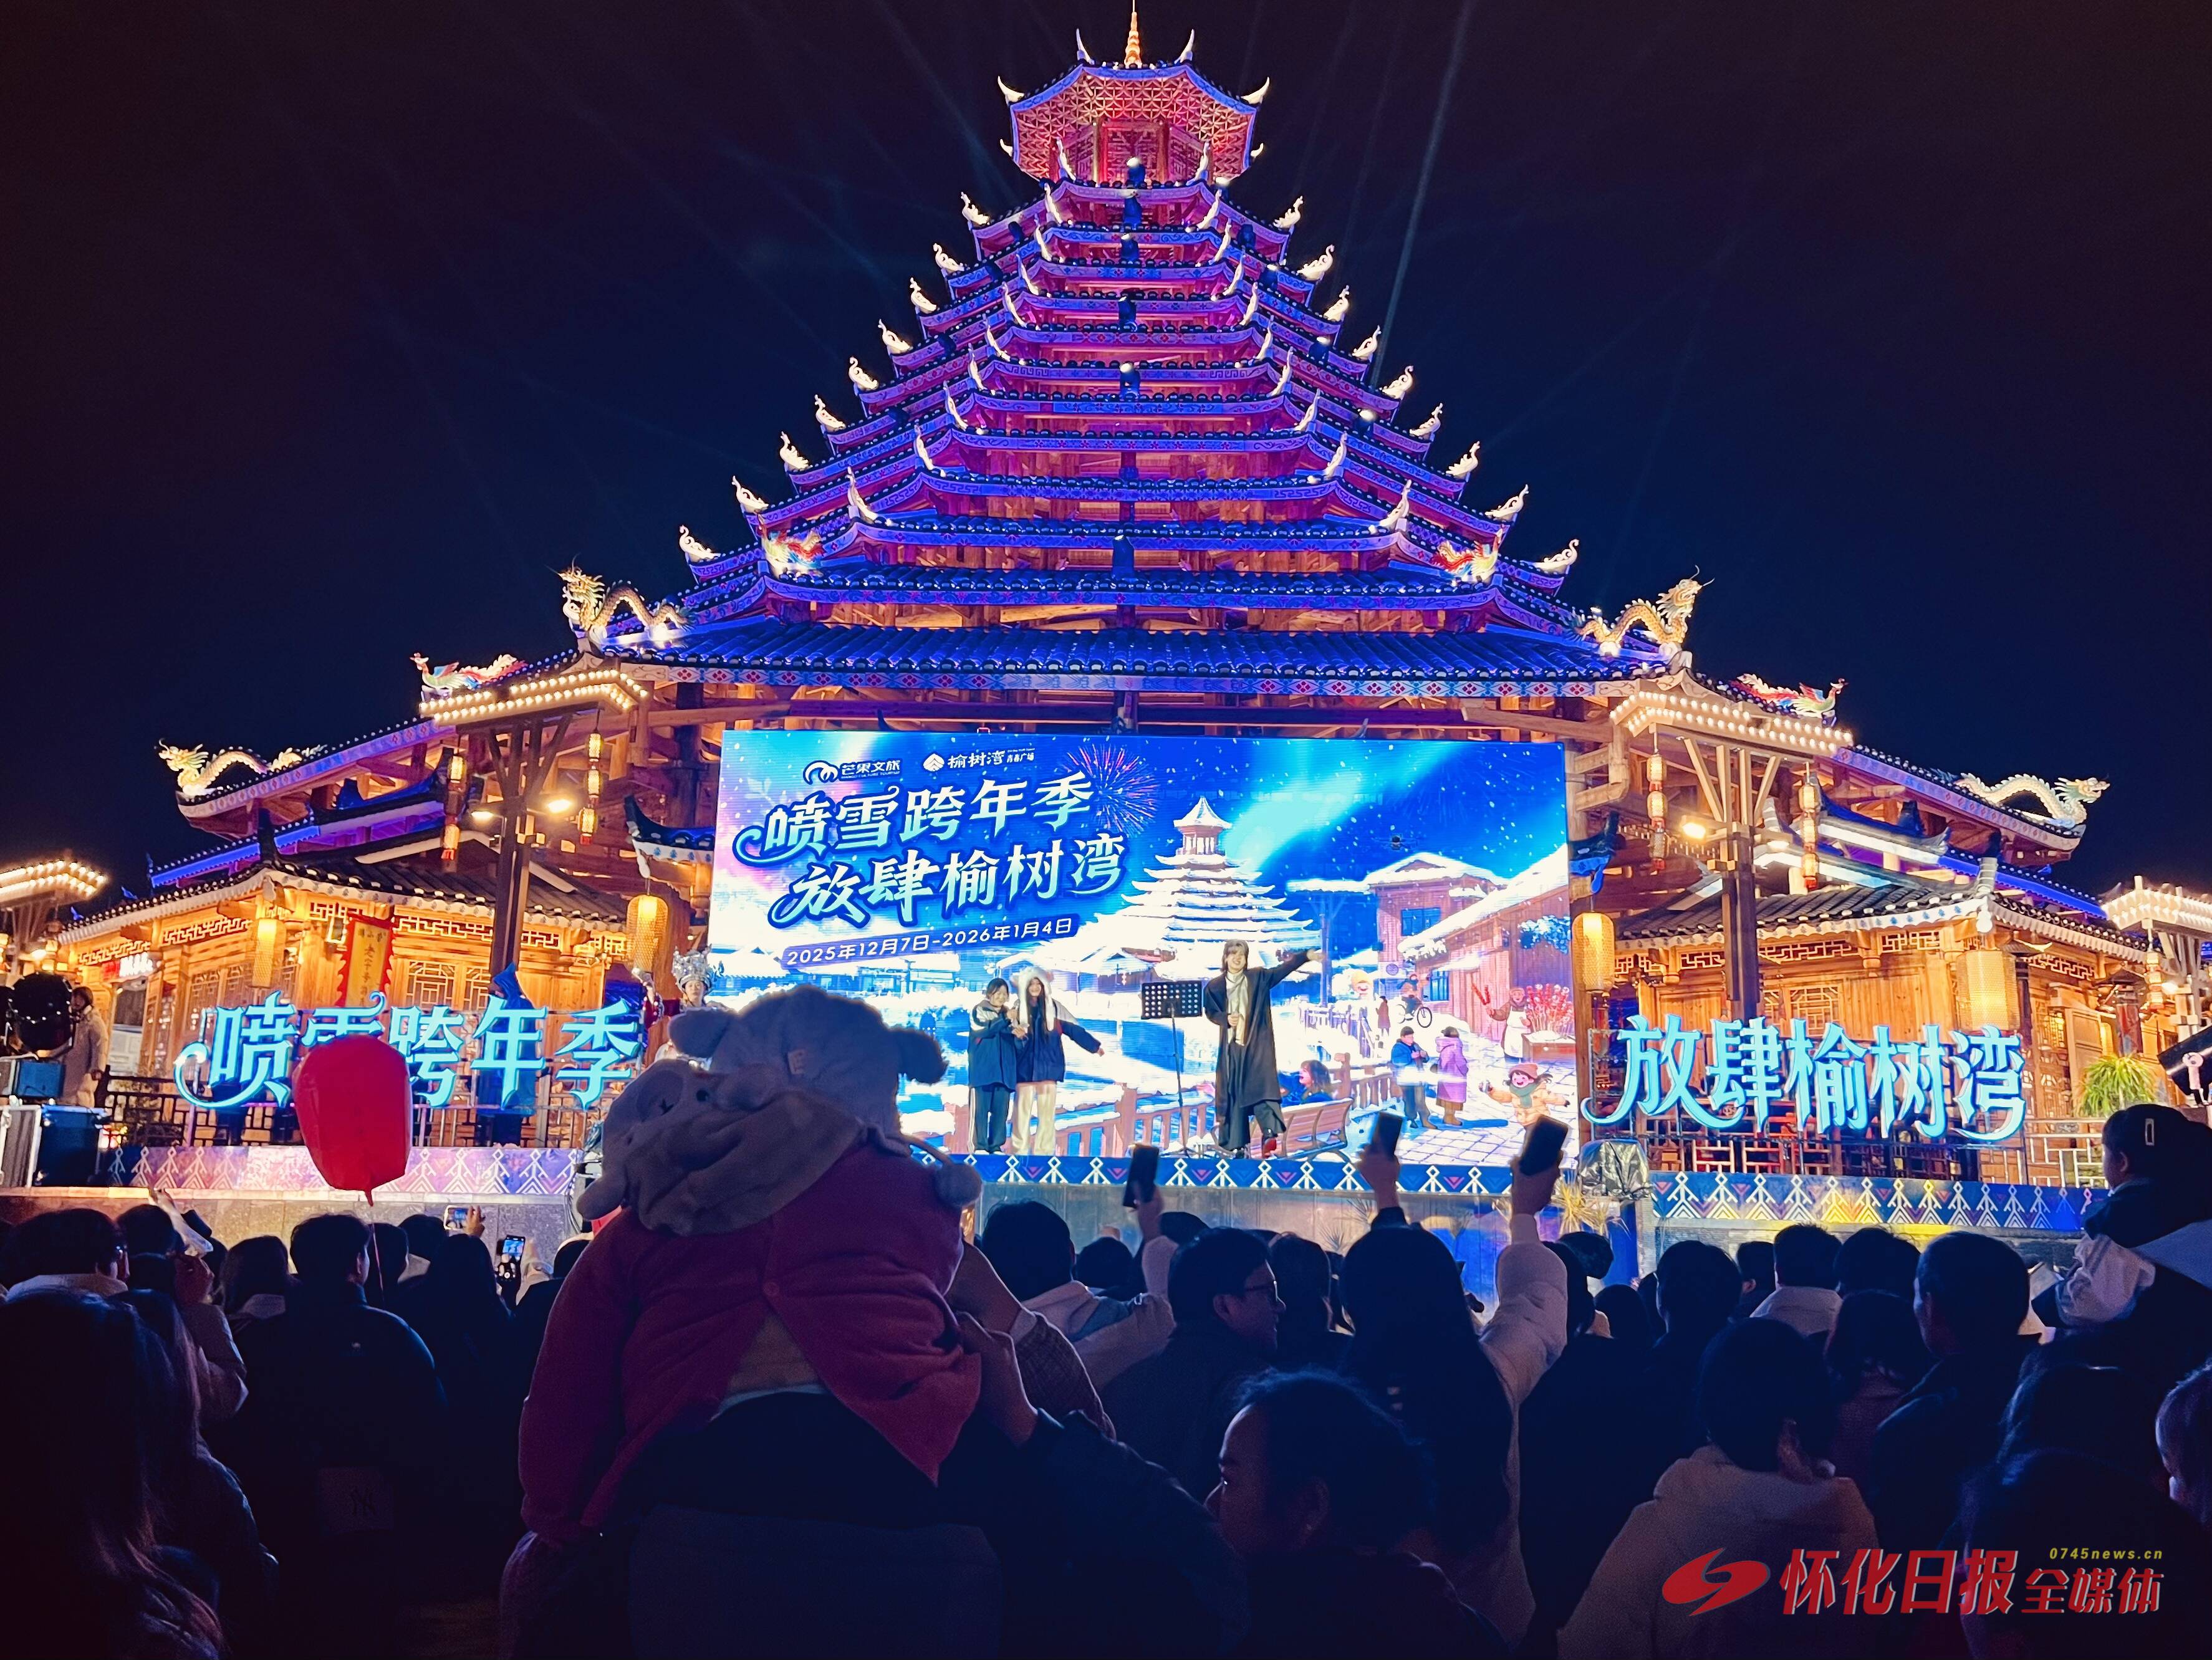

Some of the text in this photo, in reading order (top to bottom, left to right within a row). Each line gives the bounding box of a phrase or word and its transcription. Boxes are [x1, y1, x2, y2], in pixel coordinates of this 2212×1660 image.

[842, 760, 901, 775] 芒果文旅
[947, 750, 1006, 769] 榆树湾
[735, 770, 1095, 861] 喷雪跨年季
[768, 833, 1127, 928] 放肆榆树湾
[787, 918, 1072, 965] 2025年12月7日-2026年1月4日
[1580, 1014, 2026, 1141] 放肆榆树湾
